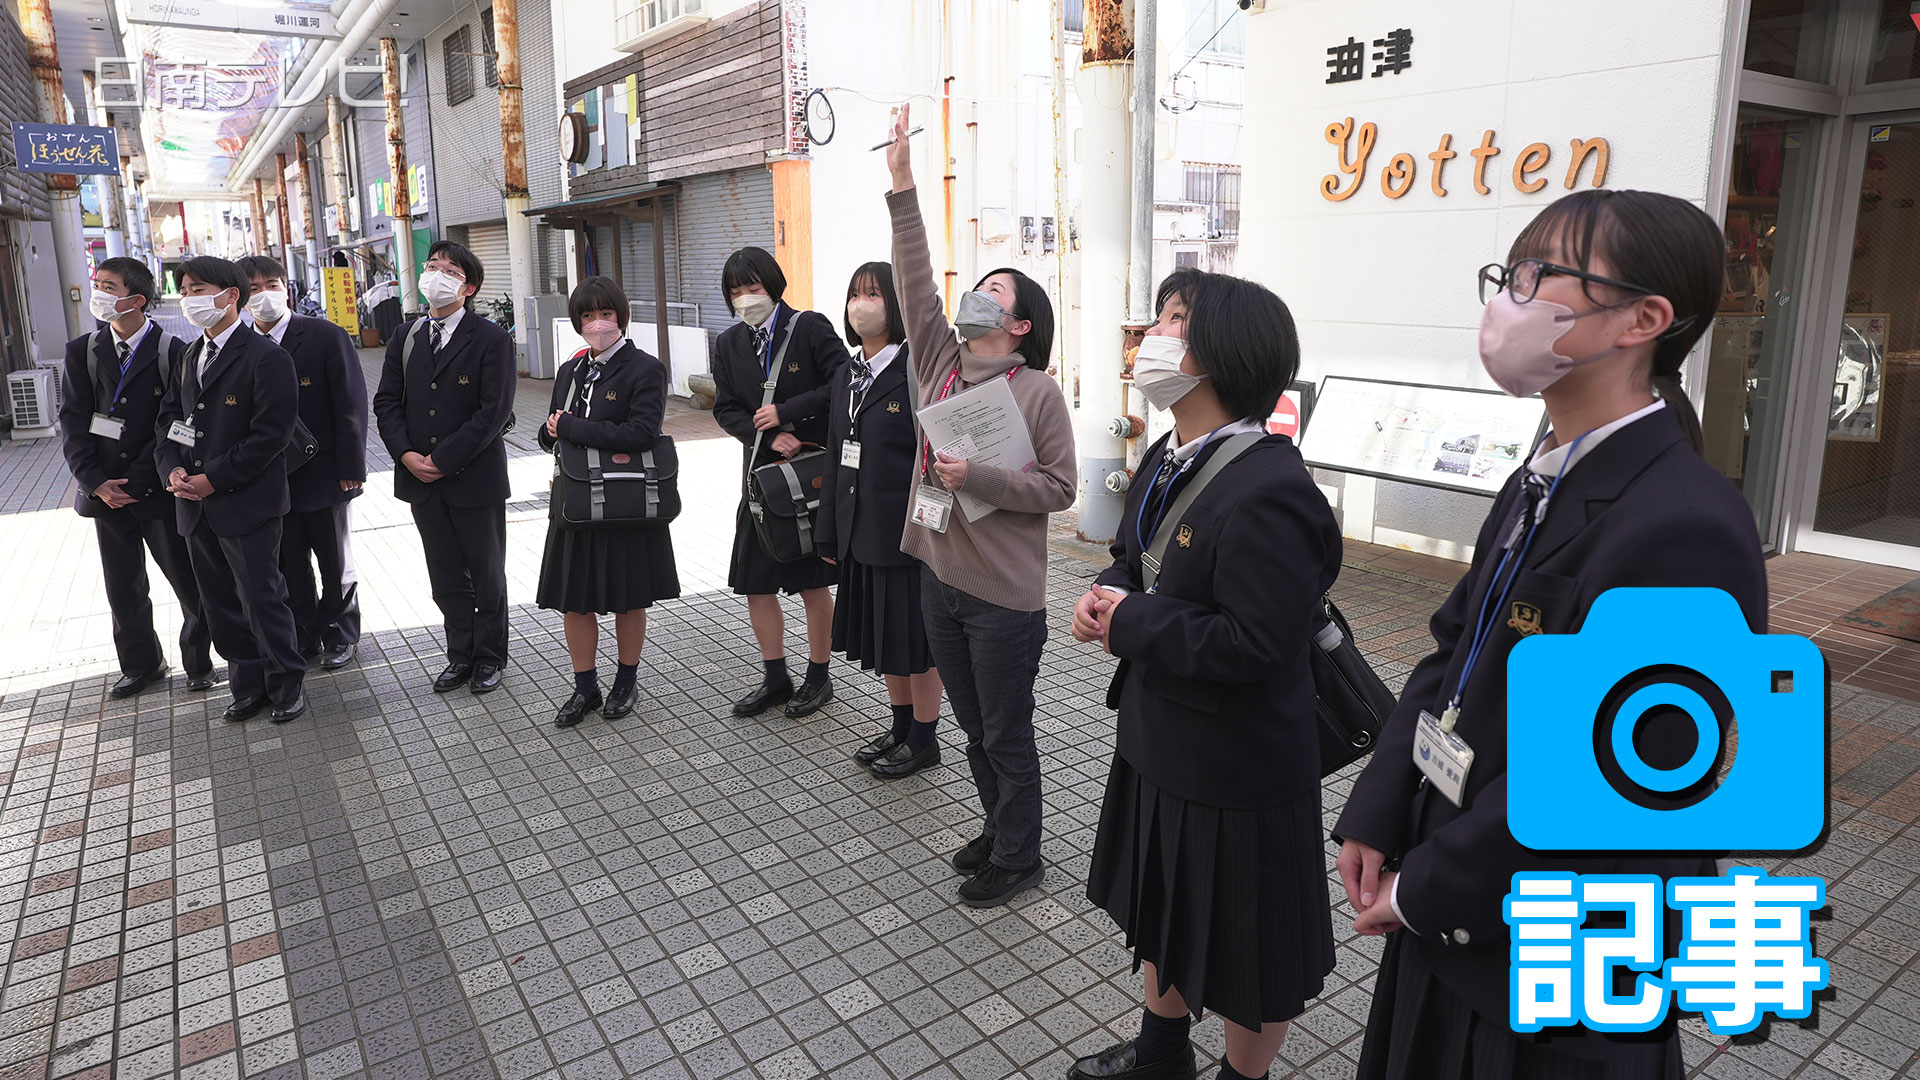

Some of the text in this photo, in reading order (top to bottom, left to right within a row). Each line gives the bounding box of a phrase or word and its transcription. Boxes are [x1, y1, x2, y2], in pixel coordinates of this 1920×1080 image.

[274, 13, 320, 29] 堀川運河
[1325, 28, 1414, 85] 油津
[45, 131, 91, 143] おでん
[1319, 116, 1611, 202] Yotten
[342, 271, 356, 315] 自転車修理
